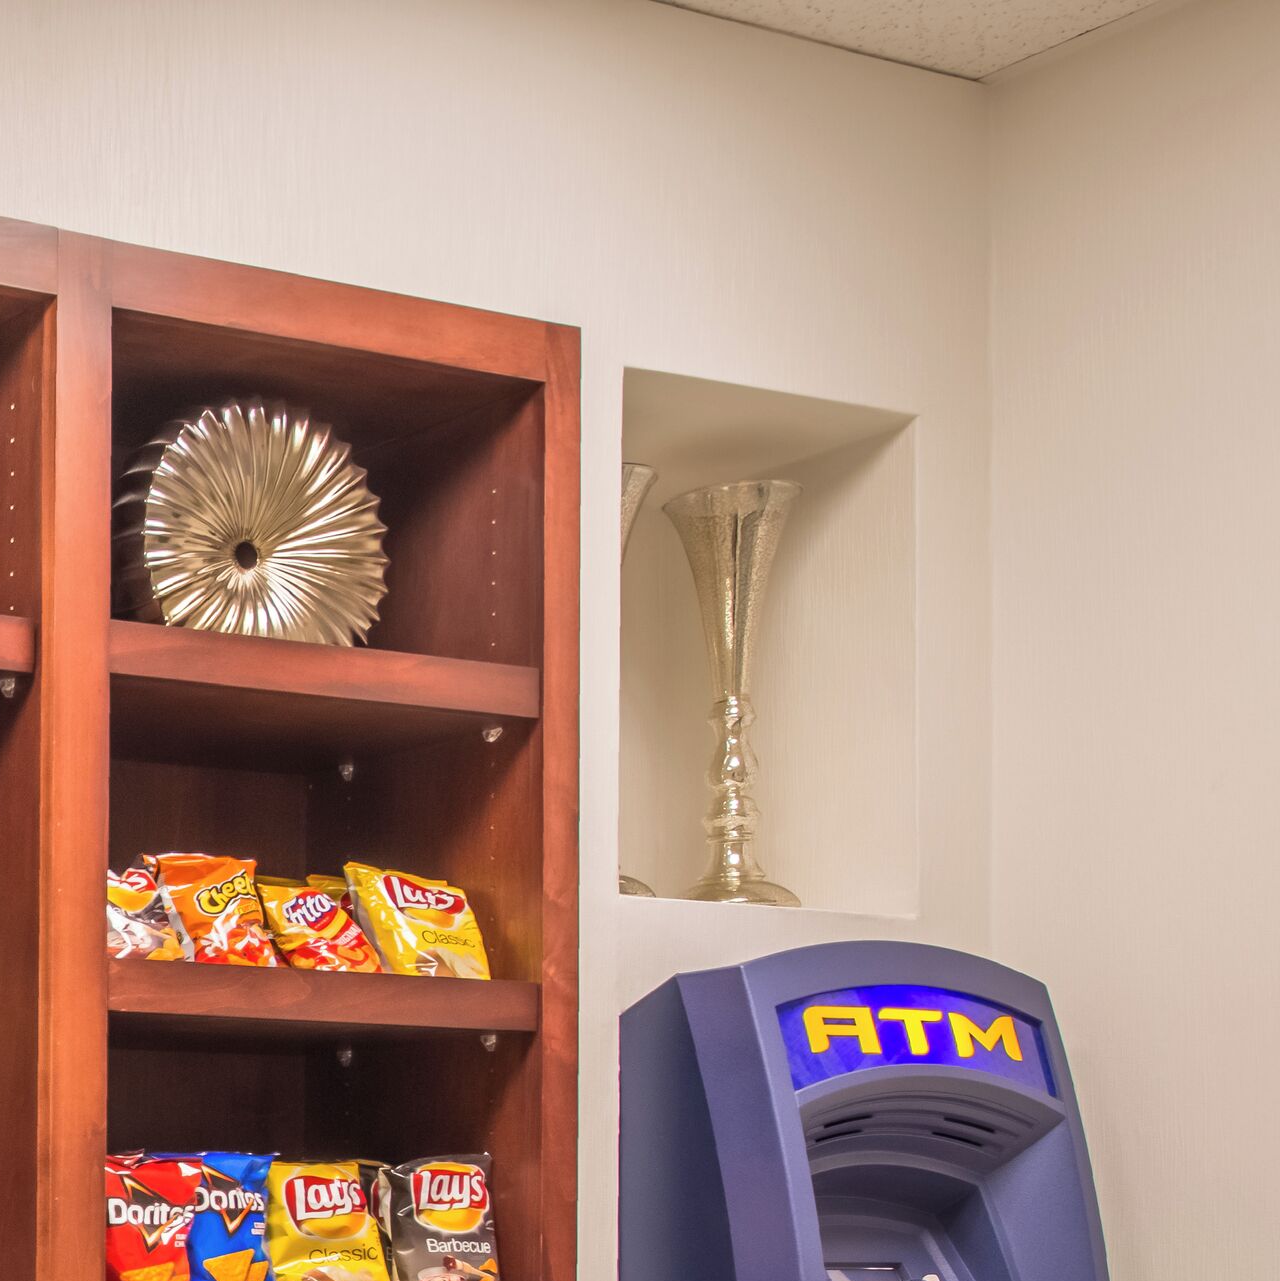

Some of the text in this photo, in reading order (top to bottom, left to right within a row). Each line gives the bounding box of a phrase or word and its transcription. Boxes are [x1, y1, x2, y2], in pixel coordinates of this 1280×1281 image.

[197, 872, 257, 915] Cheet
[420, 928, 476, 949] Classic
[802, 1005, 1023, 1062] ATM
[195, 1186, 265, 1213] Doritos
[294, 1176, 361, 1221] Lay's
[419, 1169, 484, 1211] Lay's
[108, 1198, 195, 1226] Doritos
[308, 1243, 378, 1265] Classic
[426, 1238, 491, 1255] Barbecue
